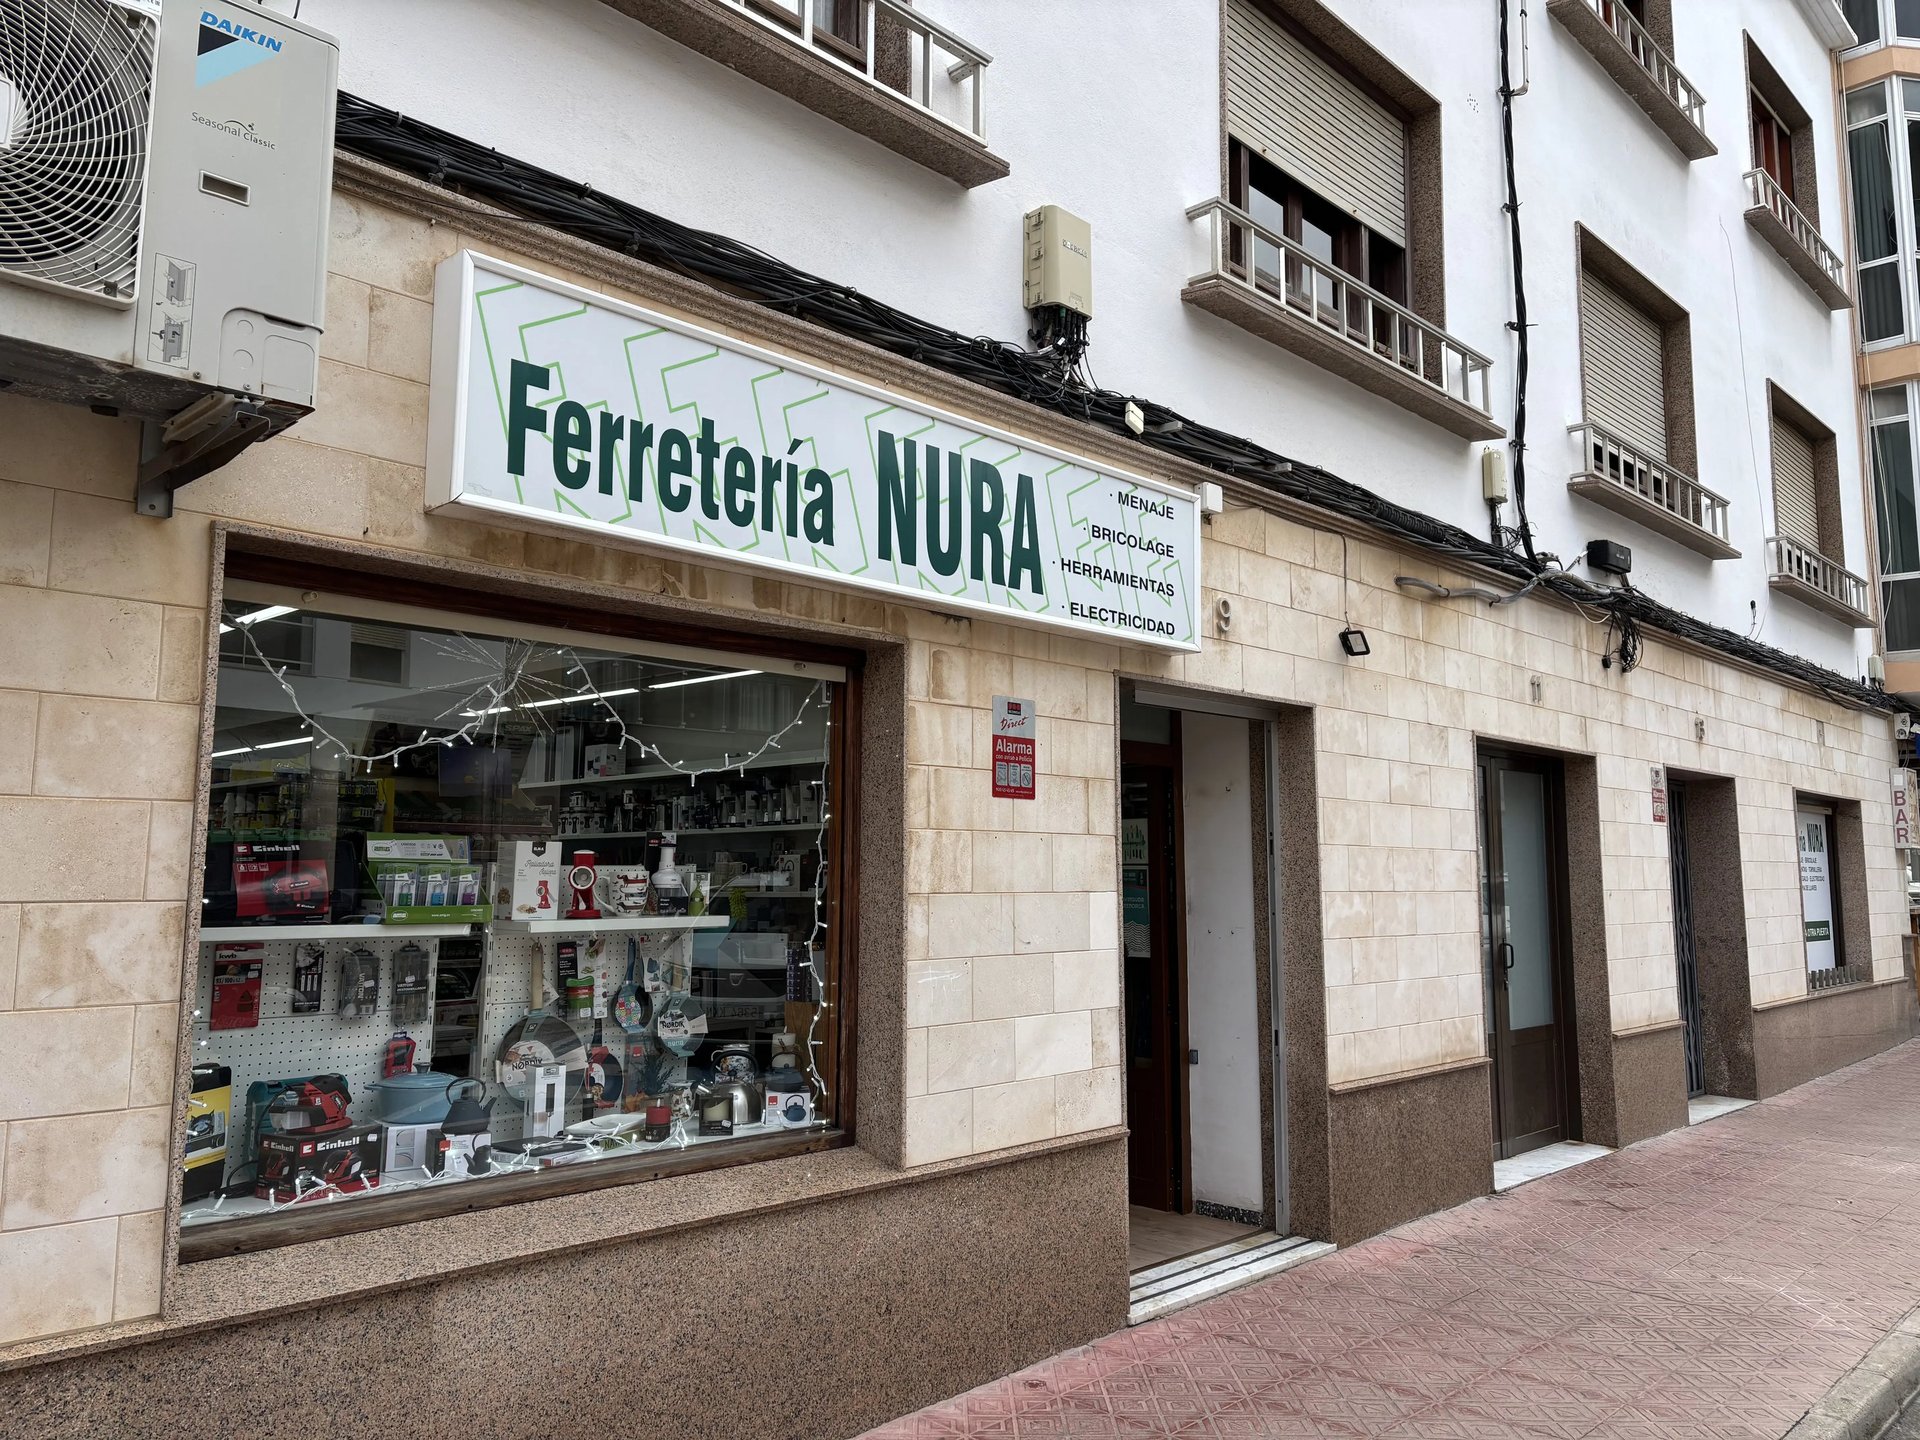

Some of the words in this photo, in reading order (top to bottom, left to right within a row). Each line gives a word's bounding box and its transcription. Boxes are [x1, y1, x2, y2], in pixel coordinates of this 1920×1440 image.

[200, 11, 282, 52] DAIKIN
[191, 111, 240, 137] Seasonal
[243, 131, 276, 150] Classic
[507, 358, 834, 547] Ferretería
[878, 429, 1044, 596] NURA
[1117, 491, 1175, 520] MENAJE
[1091, 525, 1174, 558] BRICOLAGE
[1060, 557, 1175, 597] HERRAMIENTAS
[1070, 602, 1175, 636] ELECTRICIDAD
[1216, 597, 1231, 631] 9
[996, 738, 1033, 755] Alarma
[1893, 790, 1910, 844] BAR
[252, 844, 301, 852] Einhell
[218, 952, 237, 960] kwb
[270, 1141, 294, 1152] Einhell
[316, 1136, 360, 1152] Einhell
